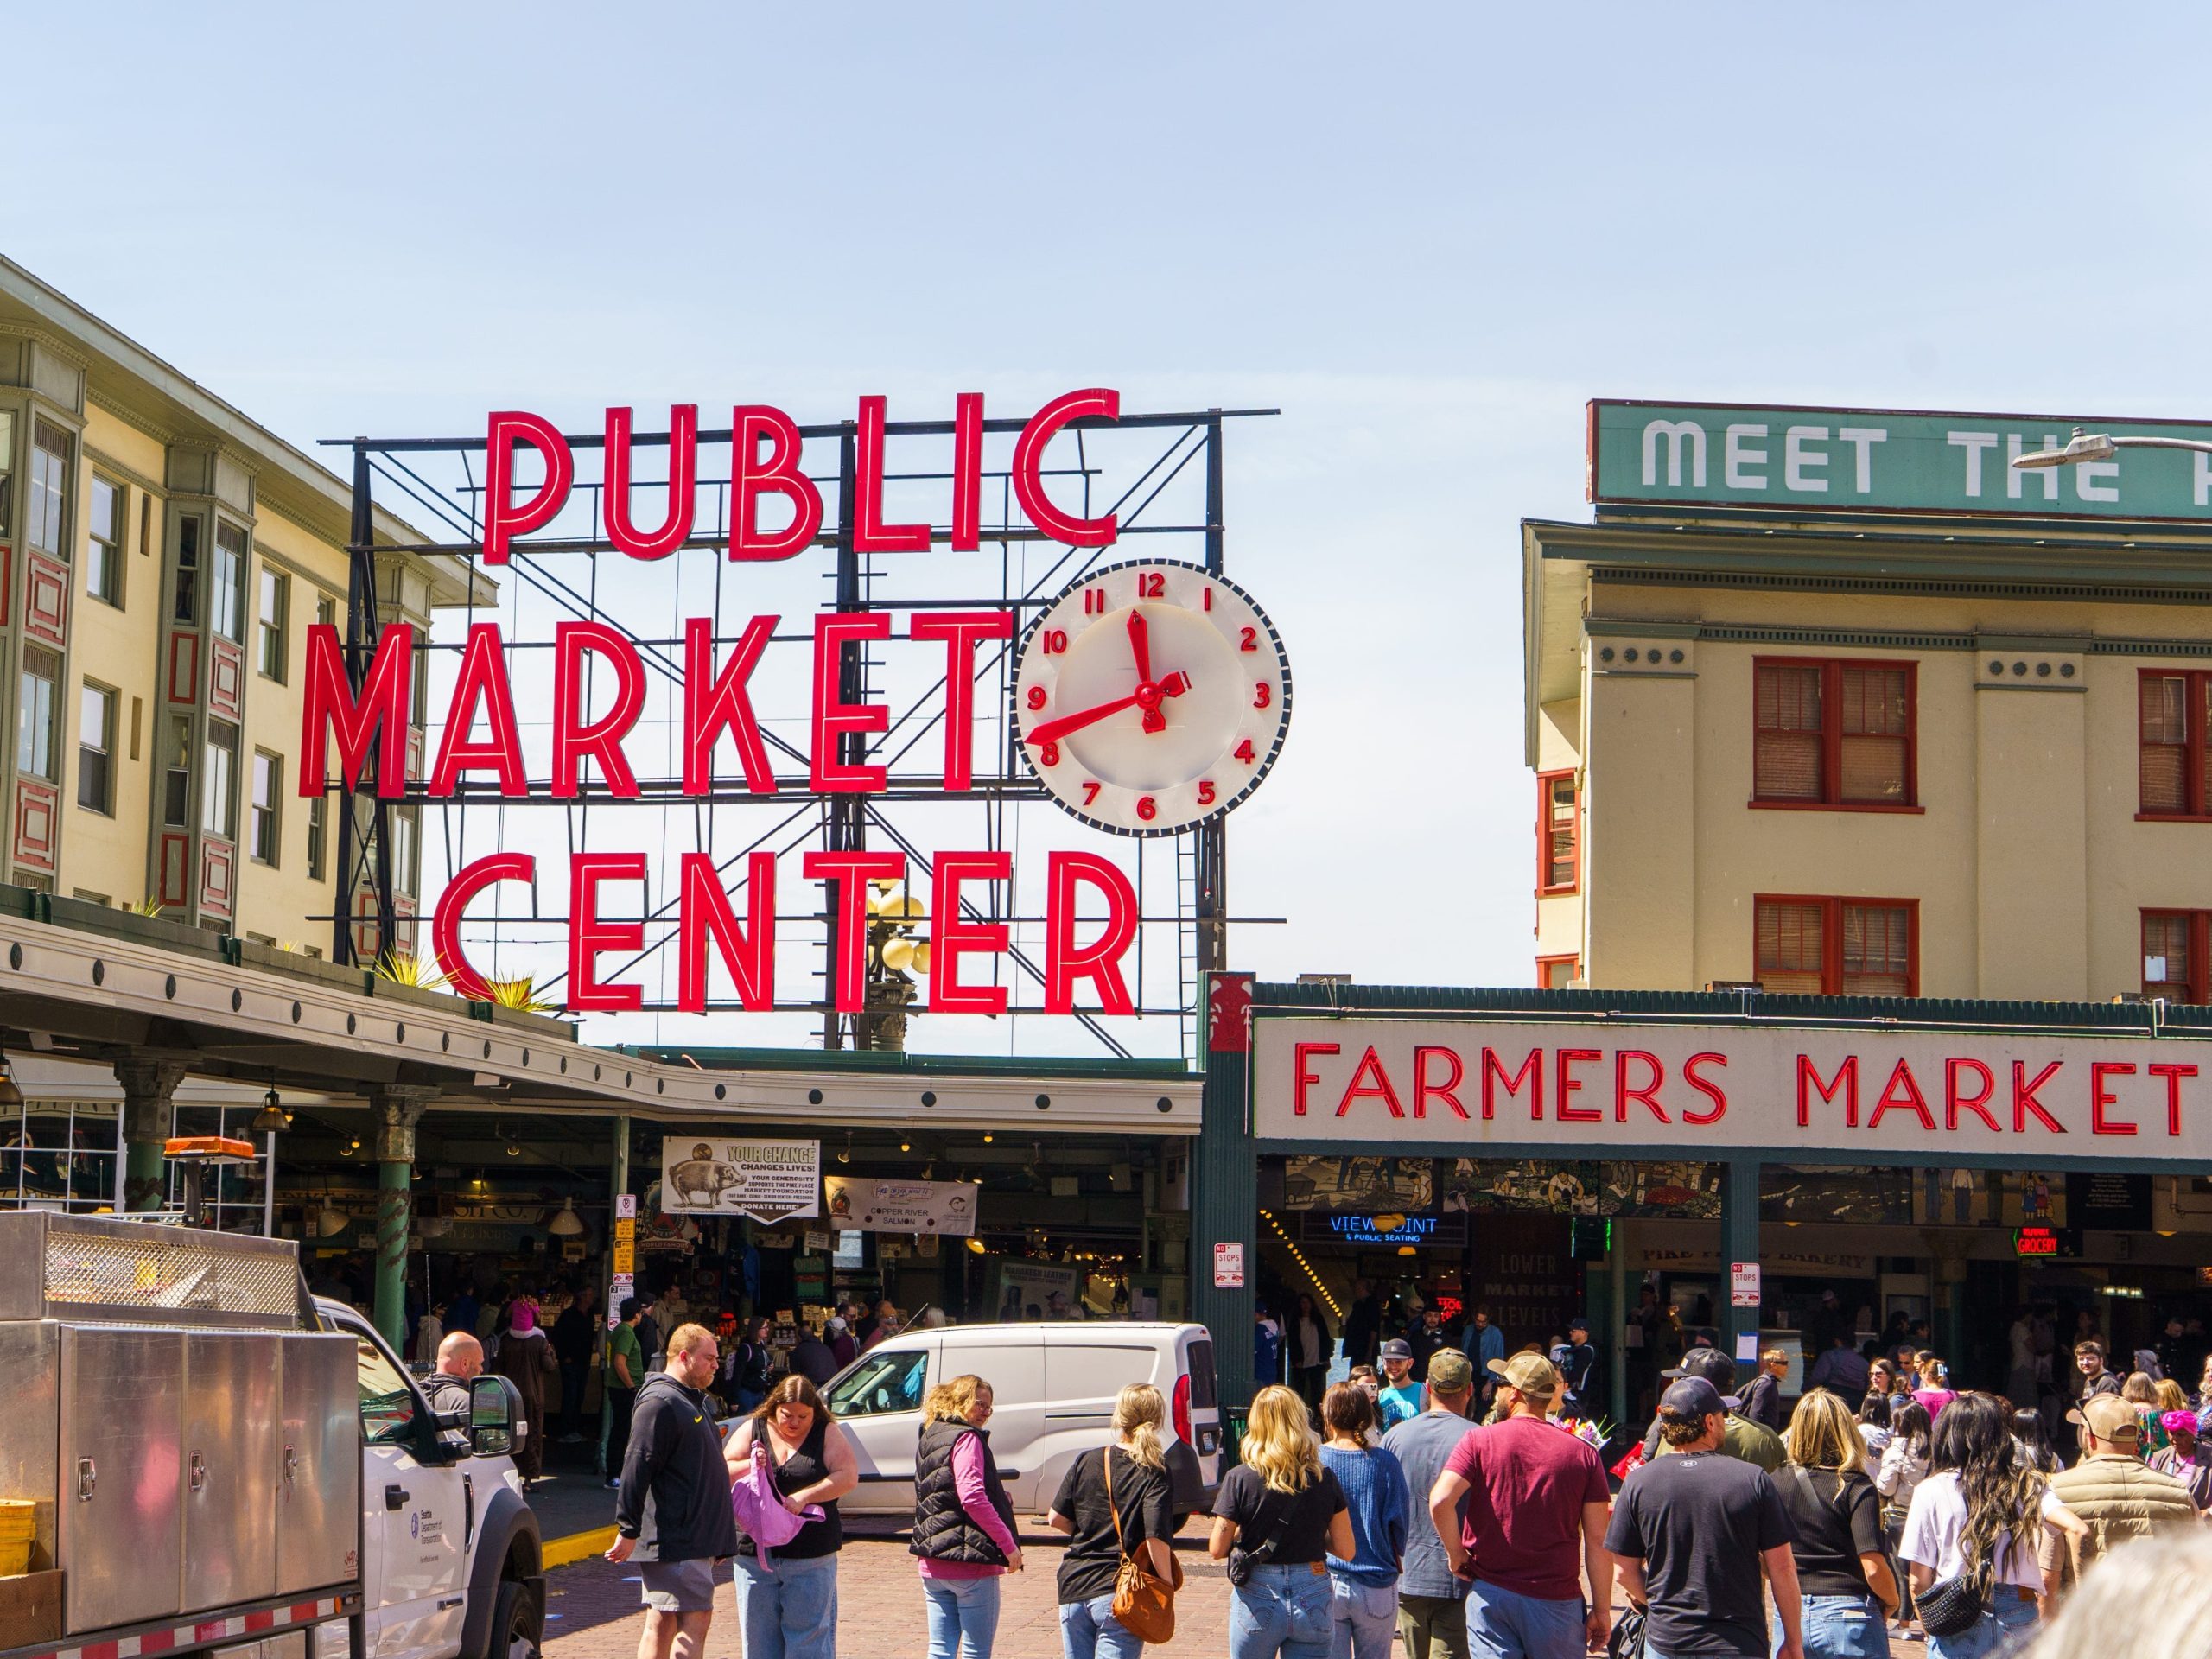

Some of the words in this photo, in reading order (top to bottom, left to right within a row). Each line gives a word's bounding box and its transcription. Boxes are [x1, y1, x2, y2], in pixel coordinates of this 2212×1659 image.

[1641, 420, 1887, 493] MEET
[1948, 431, 2119, 502] THE
[482, 387, 1120, 565] PUBLIC
[1138, 573, 1165, 598] 12
[1085, 589, 1103, 614] 11
[1204, 588, 1211, 612] 1
[1043, 630, 1068, 655] 10
[1240, 627, 1257, 652] 2
[298, 610, 1014, 799] MARKET
[1027, 686, 1046, 710] 9
[1253, 682, 1271, 709] 3
[1040, 743, 1060, 767] 8
[1233, 739, 1255, 765] 4
[1082, 782, 1101, 806] 7
[1197, 781, 1216, 805] 5
[1136, 797, 1156, 821] 6
[433, 850, 1139, 1016] CENTER
[1292, 1041, 1728, 1127] FARMERS
[1796, 1052, 2200, 1136] MARKET
[727, 1146, 762, 1163] YOUR
[764, 1147, 816, 1164] CHANGE
[871, 1207, 903, 1217] COPPER
[883, 1217, 916, 1226] SALMON
[1331, 1217, 1437, 1233] VIEWOINT
[1385, 1234, 1421, 1243] SEATING
[2018, 1237, 2057, 1253] GROCERY
[1500, 1254, 1556, 1274] LOWER
[1484, 1283, 1574, 1298] MARKET
[1498, 1306, 1561, 1327] LEVELS
[421, 1510, 433, 1519] Seattle
[421, 1522, 439, 1532] Department
[421, 1534, 442, 1545] Transportation
